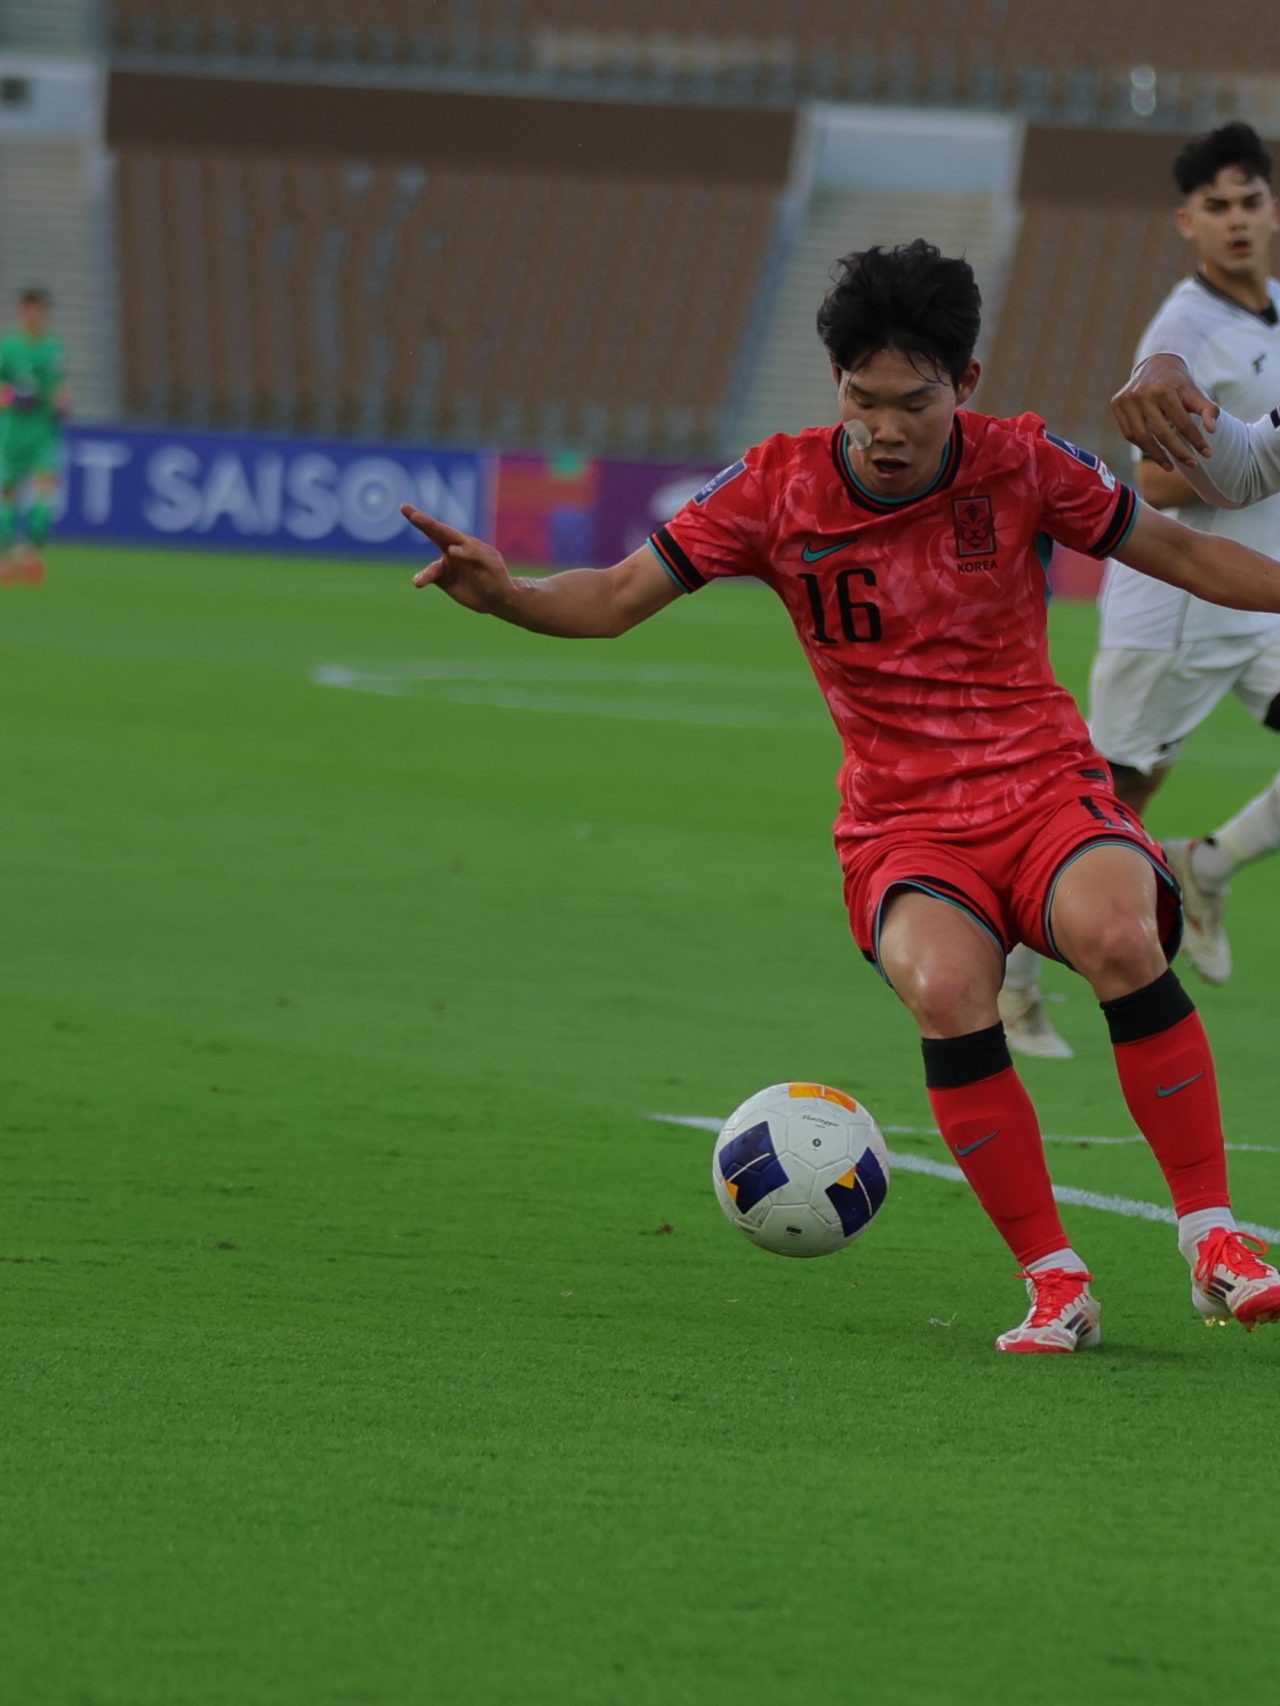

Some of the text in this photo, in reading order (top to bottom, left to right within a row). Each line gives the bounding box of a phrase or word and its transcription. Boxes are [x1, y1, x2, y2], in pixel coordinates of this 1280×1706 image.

[145, 445, 475, 541] SAISON
[957, 560, 999, 573] KOREA
[798, 568, 883, 644] 16
